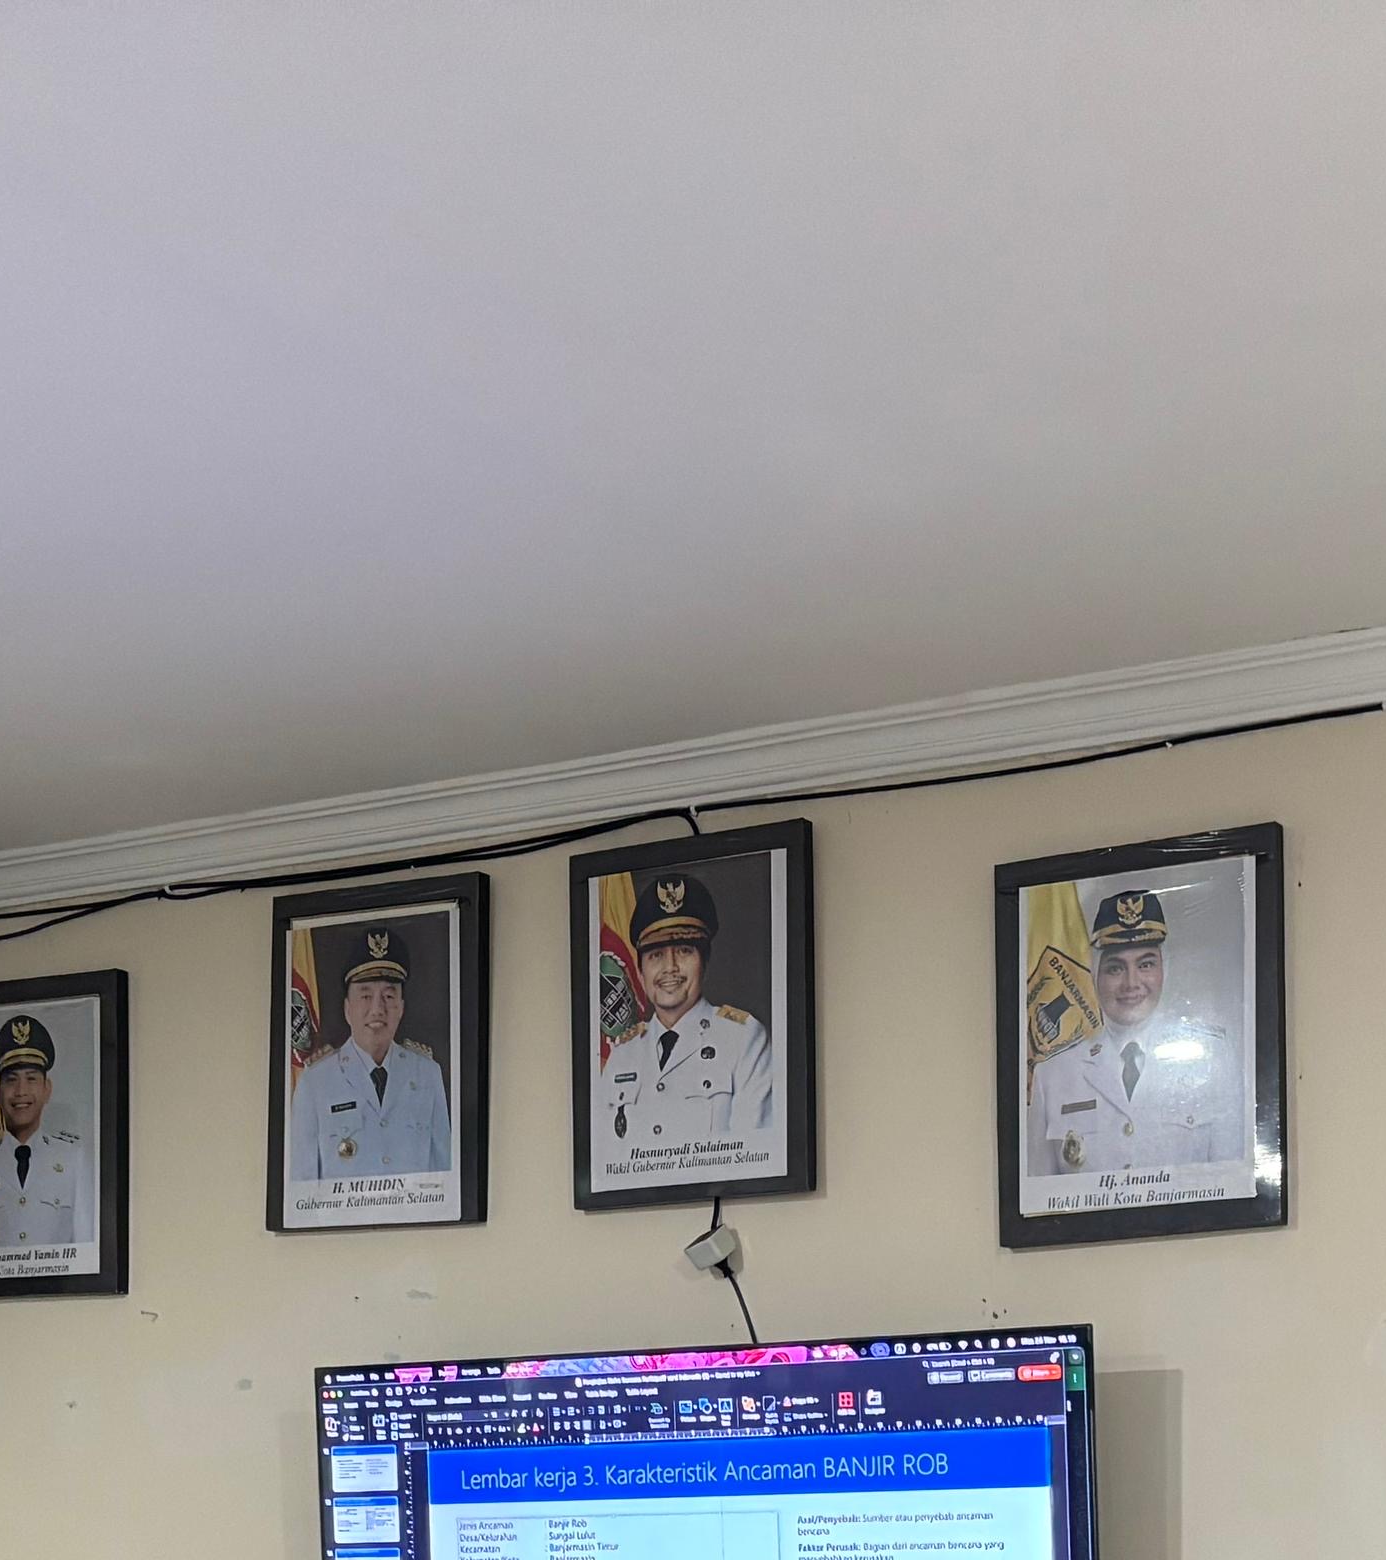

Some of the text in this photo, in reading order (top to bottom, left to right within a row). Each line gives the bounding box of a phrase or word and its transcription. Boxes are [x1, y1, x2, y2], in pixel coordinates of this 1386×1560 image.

[1049, 956, 1100, 1029] BANJARMASIN
[630, 1140, 744, 1160] Hasnuryadi Sulaiman
[605, 1152, 770, 1175] Wakil Gubernur Kalimantan Selatan
[333, 1178, 406, 1194] H. MUHIDIN
[1099, 1170, 1171, 1190] Hj. Ananda
[295, 1193, 445, 1210] Gubernur Kalimantan Selatan
[1047, 1187, 1225, 1209] Wakil Wali Kota Banjarmasin
[34, 1249, 60, 1261] Yamin
[62, 1247, 77, 1259] HR
[461, 1452, 949, 1493] Lembar kerja 3. Karakteristik Ancaman BANJIR ROB
[479, 1521, 514, 1530] Ancaman
[572, 1518, 587, 1528] Rob
[915, 1512, 954, 1523] penyebab
[956, 1512, 994, 1520] ancaman
[548, 1531, 575, 1542] Sungai
[576, 1530, 596, 1540] Lulut
[460, 1544, 501, 1554] Kecamatan
[549, 1543, 596, 1553] Banjarmasin
[909, 1542, 946, 1550] ancaman
[947, 1541, 983, 1550] bencana
